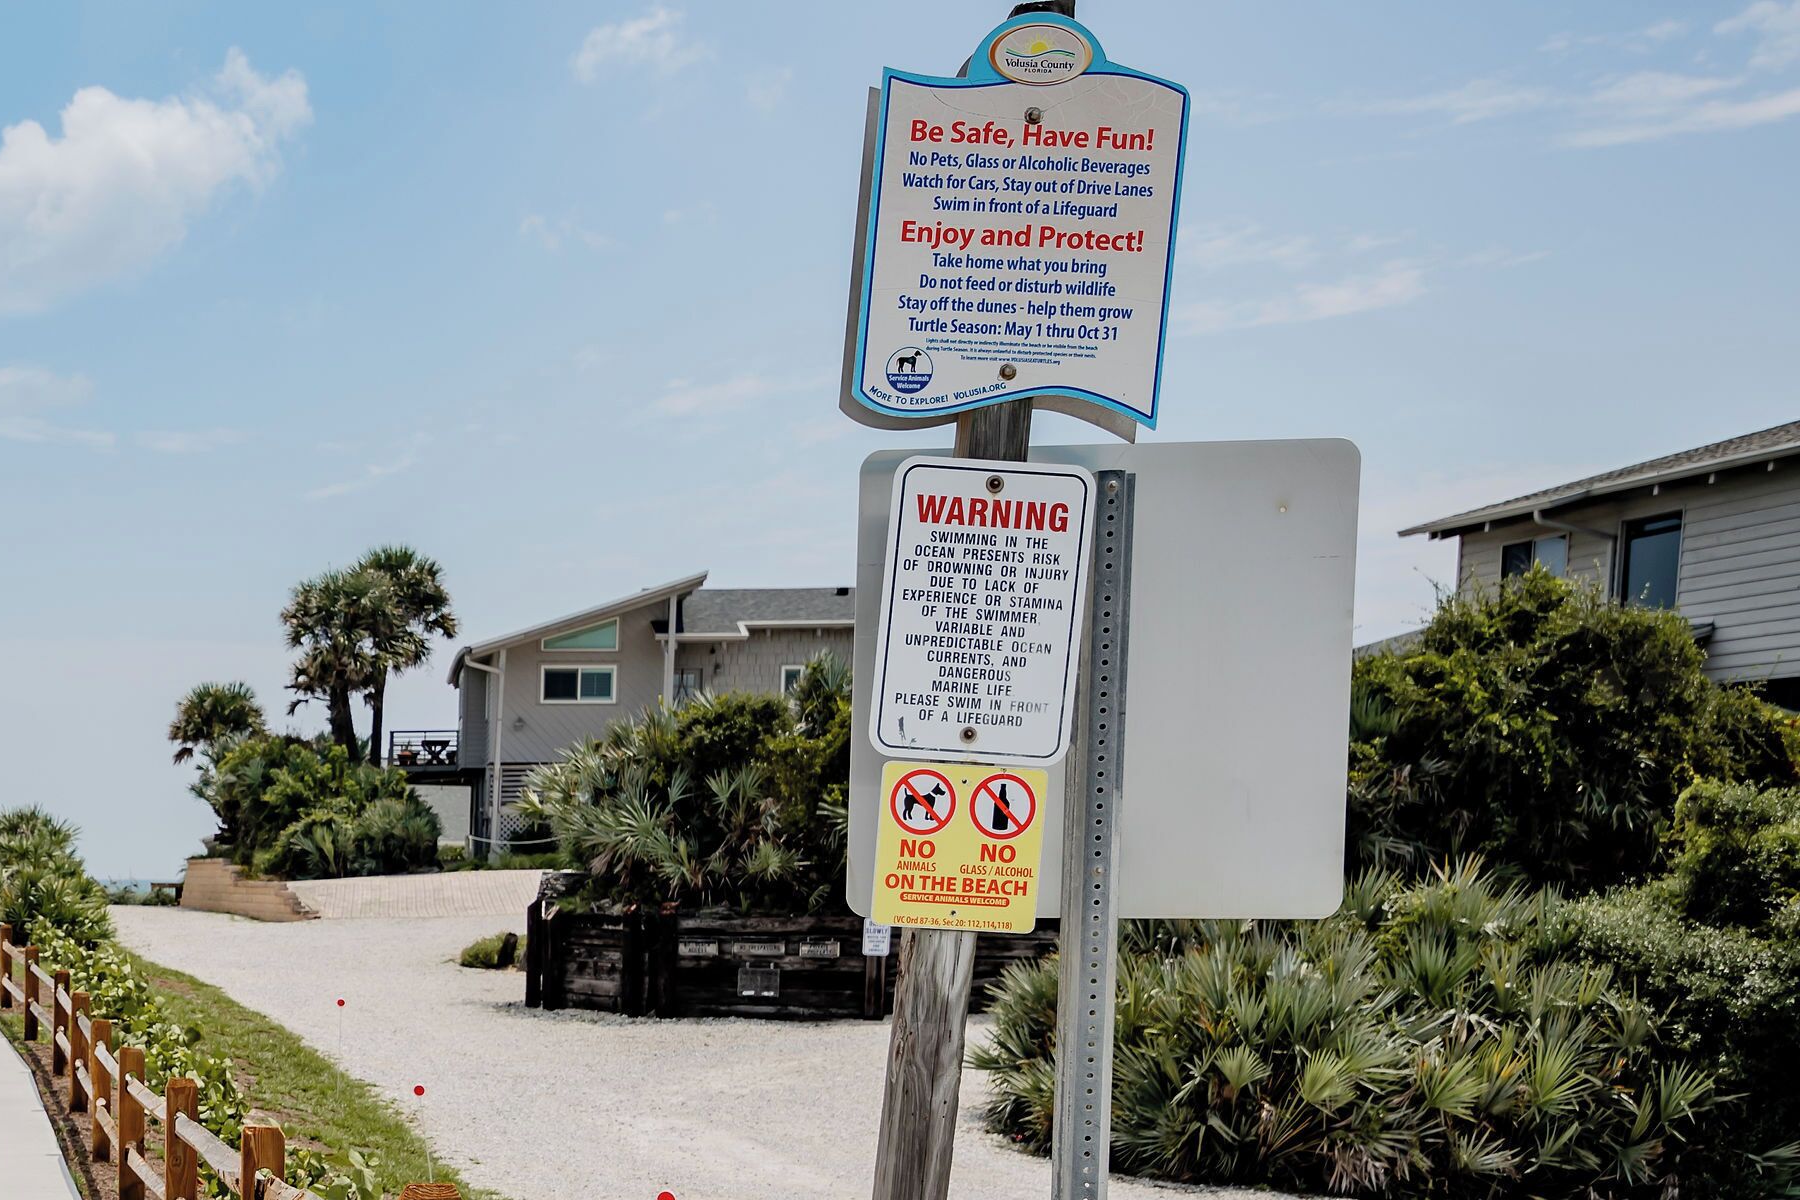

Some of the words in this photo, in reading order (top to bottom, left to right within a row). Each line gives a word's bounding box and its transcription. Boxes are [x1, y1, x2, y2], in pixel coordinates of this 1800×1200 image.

[1006, 58, 1037, 67] Volusia
[1041, 60, 1074, 71] County
[911, 120, 944, 142] Be
[951, 121, 1014, 148] Safe,
[1023, 124, 1089, 148] Have
[1097, 127, 1154, 151] Fun!
[910, 151, 927, 166] No
[931, 152, 962, 169] Pets,
[966, 153, 999, 168] Glass
[1002, 159, 1017, 169] or
[1018, 156, 1079, 172] Alcoholic
[1081, 158, 1150, 178] Beverages
[903, 173, 943, 188] Watch
[947, 174, 966, 189] for
[968, 176, 999, 193] Cars,
[1002, 177, 1032, 196] Stay
[1035, 180, 1058, 193] out
[1060, 179, 1075, 194] of
[1077, 180, 1111, 195] Drive
[1115, 182, 1153, 197] Lanes
[933, 196, 970, 211] Swim
[973, 198, 985, 212] in
[989, 198, 1023, 213] front
[1026, 200, 1041, 214] of
[1042, 204, 1050, 214] a
[1053, 201, 1117, 220] Lifeguard
[901, 221, 975, 251] Enjoy
[981, 224, 1032, 247] and
[1039, 226, 1144, 252] Protect!
[933, 253, 963, 268] Take
[966, 254, 1004, 270] home
[1007, 256, 1042, 271] what
[1044, 261, 1068, 275] you
[1071, 258, 1107, 278] bring
[920, 274, 937, 288] Do
[940, 277, 963, 290] not
[966, 276, 996, 291] feed
[998, 281, 1013, 292] or
[1015, 278, 1062, 294] disturb
[1066, 281, 1116, 296] wildlife
[898, 295, 928, 314] Stay
[930, 297, 950, 311] off
[951, 297, 974, 312] the
[977, 298, 1016, 314] dunes
[1028, 300, 1056, 319] help
[1060, 302, 1095, 317] them
[1099, 308, 1133, 322] grow
[909, 317, 947, 332] Turtle
[950, 319, 1002, 335] Season:
[1004, 321, 1032, 340] May
[1036, 323, 1042, 337] 1
[1046, 323, 1074, 338] thru
[1078, 325, 1100, 340] Oct
[1102, 326, 1117, 340] 31
[910, 395, 948, 405] EXPLORE!
[953, 382, 1006, 400] VOLUSIA.ORG
[917, 494, 1068, 532] WARNING
[930, 531, 997, 546] SWIMMING
[1005, 536, 1018, 548] IN
[1026, 537, 1048, 550] THE
[915, 544, 955, 559] OCEAN
[963, 548, 1024, 563] PRESENTS
[1033, 553, 1060, 566] RISK
[903, 559, 919, 571] OF
[928, 560, 992, 576] DROWNING
[1001, 565, 1017, 578] OR
[1025, 567, 1069, 581] INJURY
[930, 576, 954, 588] DUE
[985, 579, 1016, 593] LACK
[1024, 582, 1039, 594] OF
[902, 589, 977, 605] EXPERIENCE
[985, 594, 1002, 607] OR
[1010, 596, 1063, 611] STAMINA
[906, 634, 1003, 652] UNPREDICTABLE
[1012, 641, 1052, 655] OCEAN
[927, 650, 994, 668] CURRENTS,
[1002, 656, 1027, 668] AND
[895, 693, 940, 707] PLEASE
[947, 696, 982, 710] SWIM
[990, 699, 1002, 711] IN
[1010, 701, 1049, 712] FRONT
[919, 709, 934, 721] OF
[941, 711, 948, 722] A
[957, 712, 1023, 727] LIFEGUARD
[899, 839, 935, 858] NO
[980, 844, 1016, 863] NO
[897, 861, 936, 871] ANIMALS
[960, 864, 986, 875] GLASS
[995, 867, 1033, 878] ALCOHOL
[885, 874, 914, 889] ON
[919, 875, 956, 892] THE
[962, 878, 1027, 896] BEACH
[970, 897, 1006, 905] WELCOME
